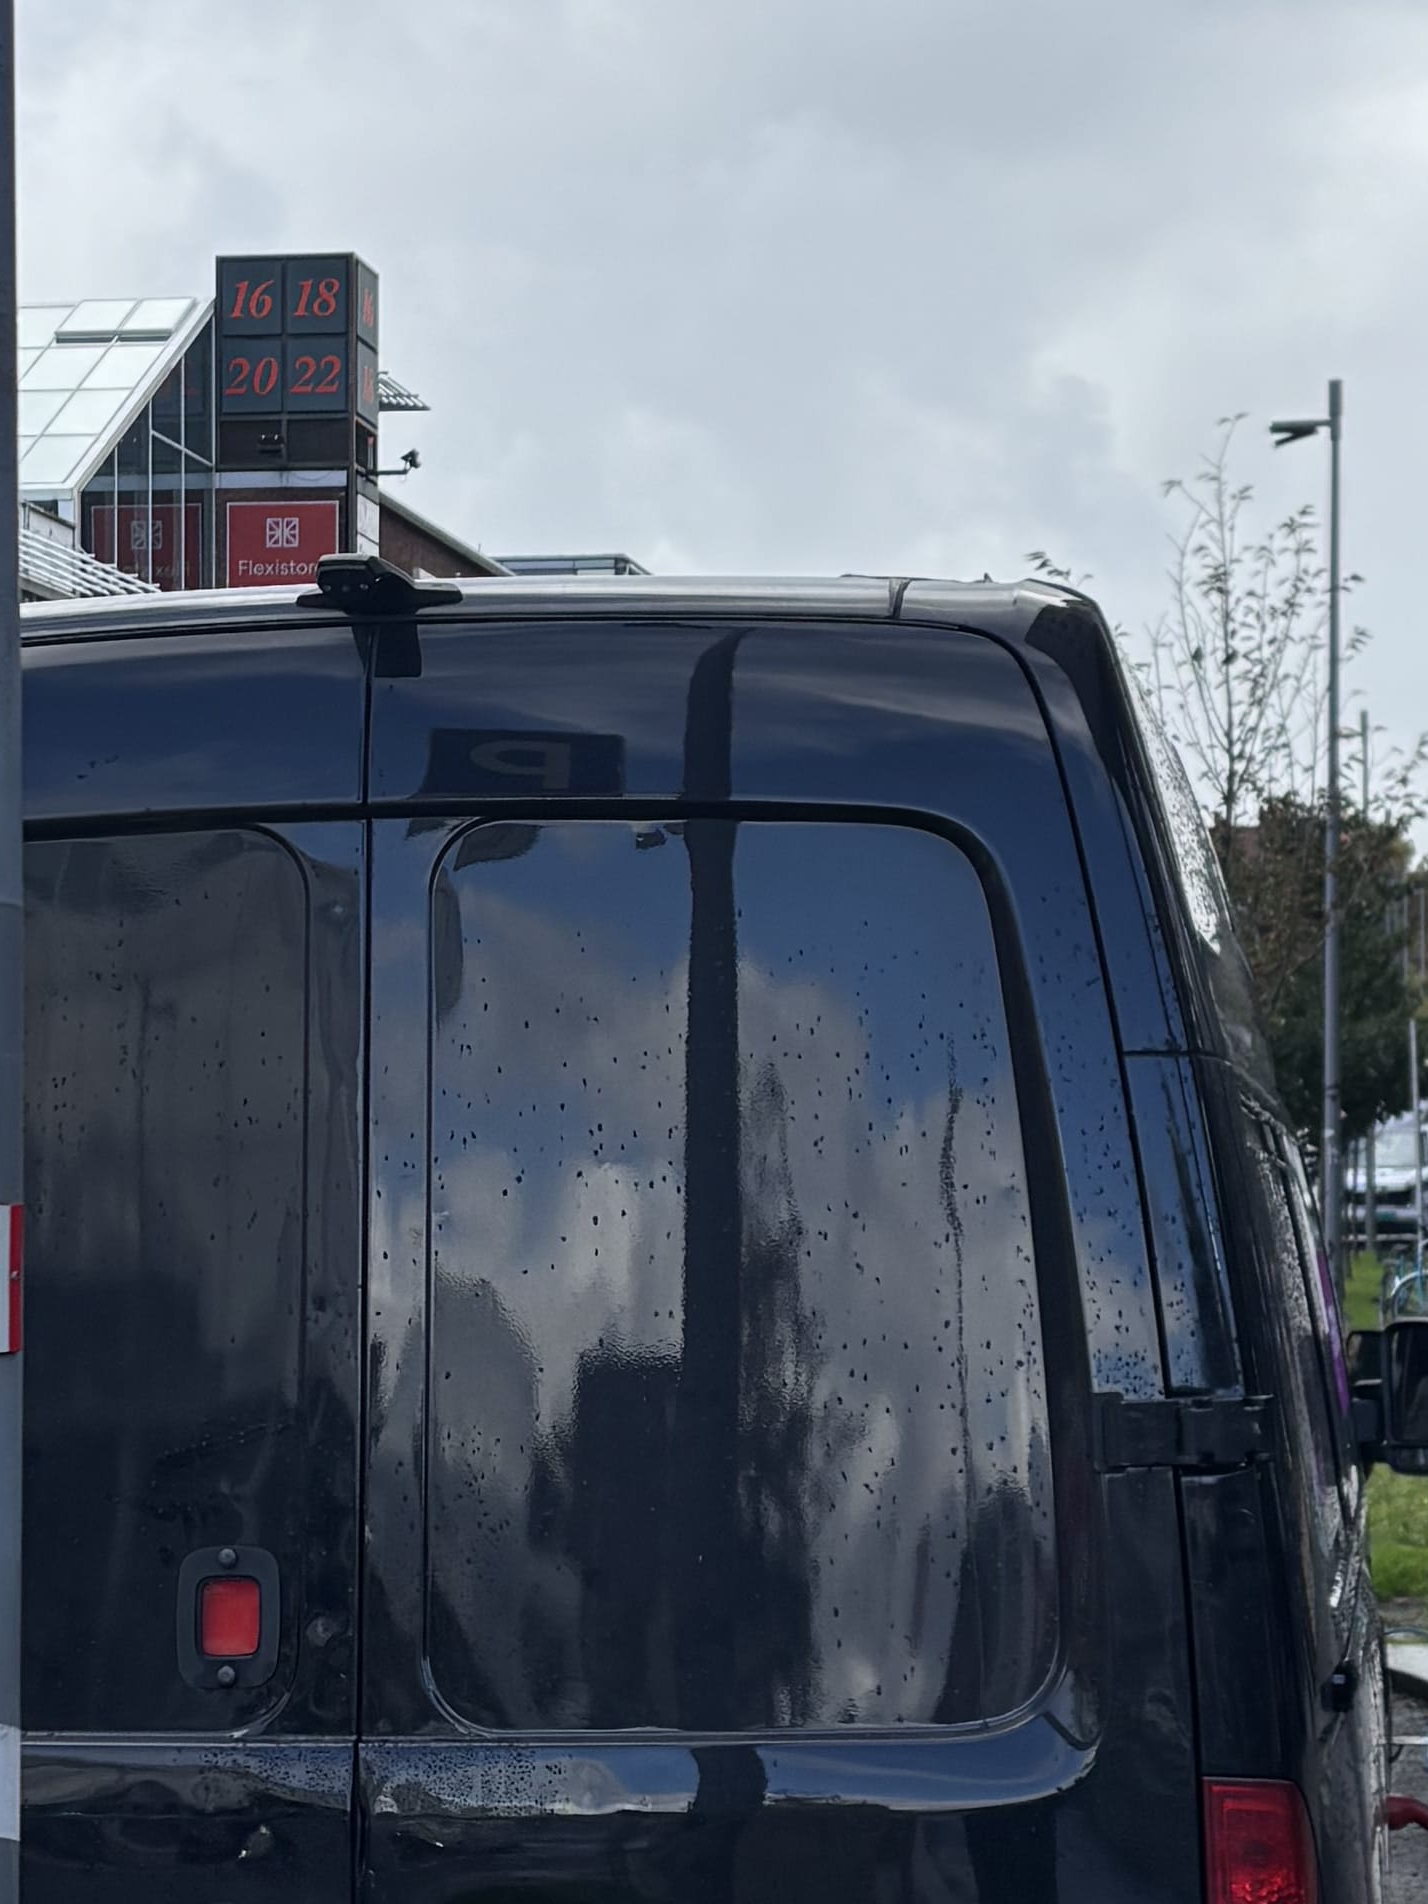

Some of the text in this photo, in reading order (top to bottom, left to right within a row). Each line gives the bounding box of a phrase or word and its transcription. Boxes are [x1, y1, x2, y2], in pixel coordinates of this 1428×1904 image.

[229, 280, 274, 319] 16
[292, 278, 340, 318] 18
[223, 357, 278, 395] 20
[289, 355, 341, 394] 22
[238, 559, 318, 576] Flexistor
